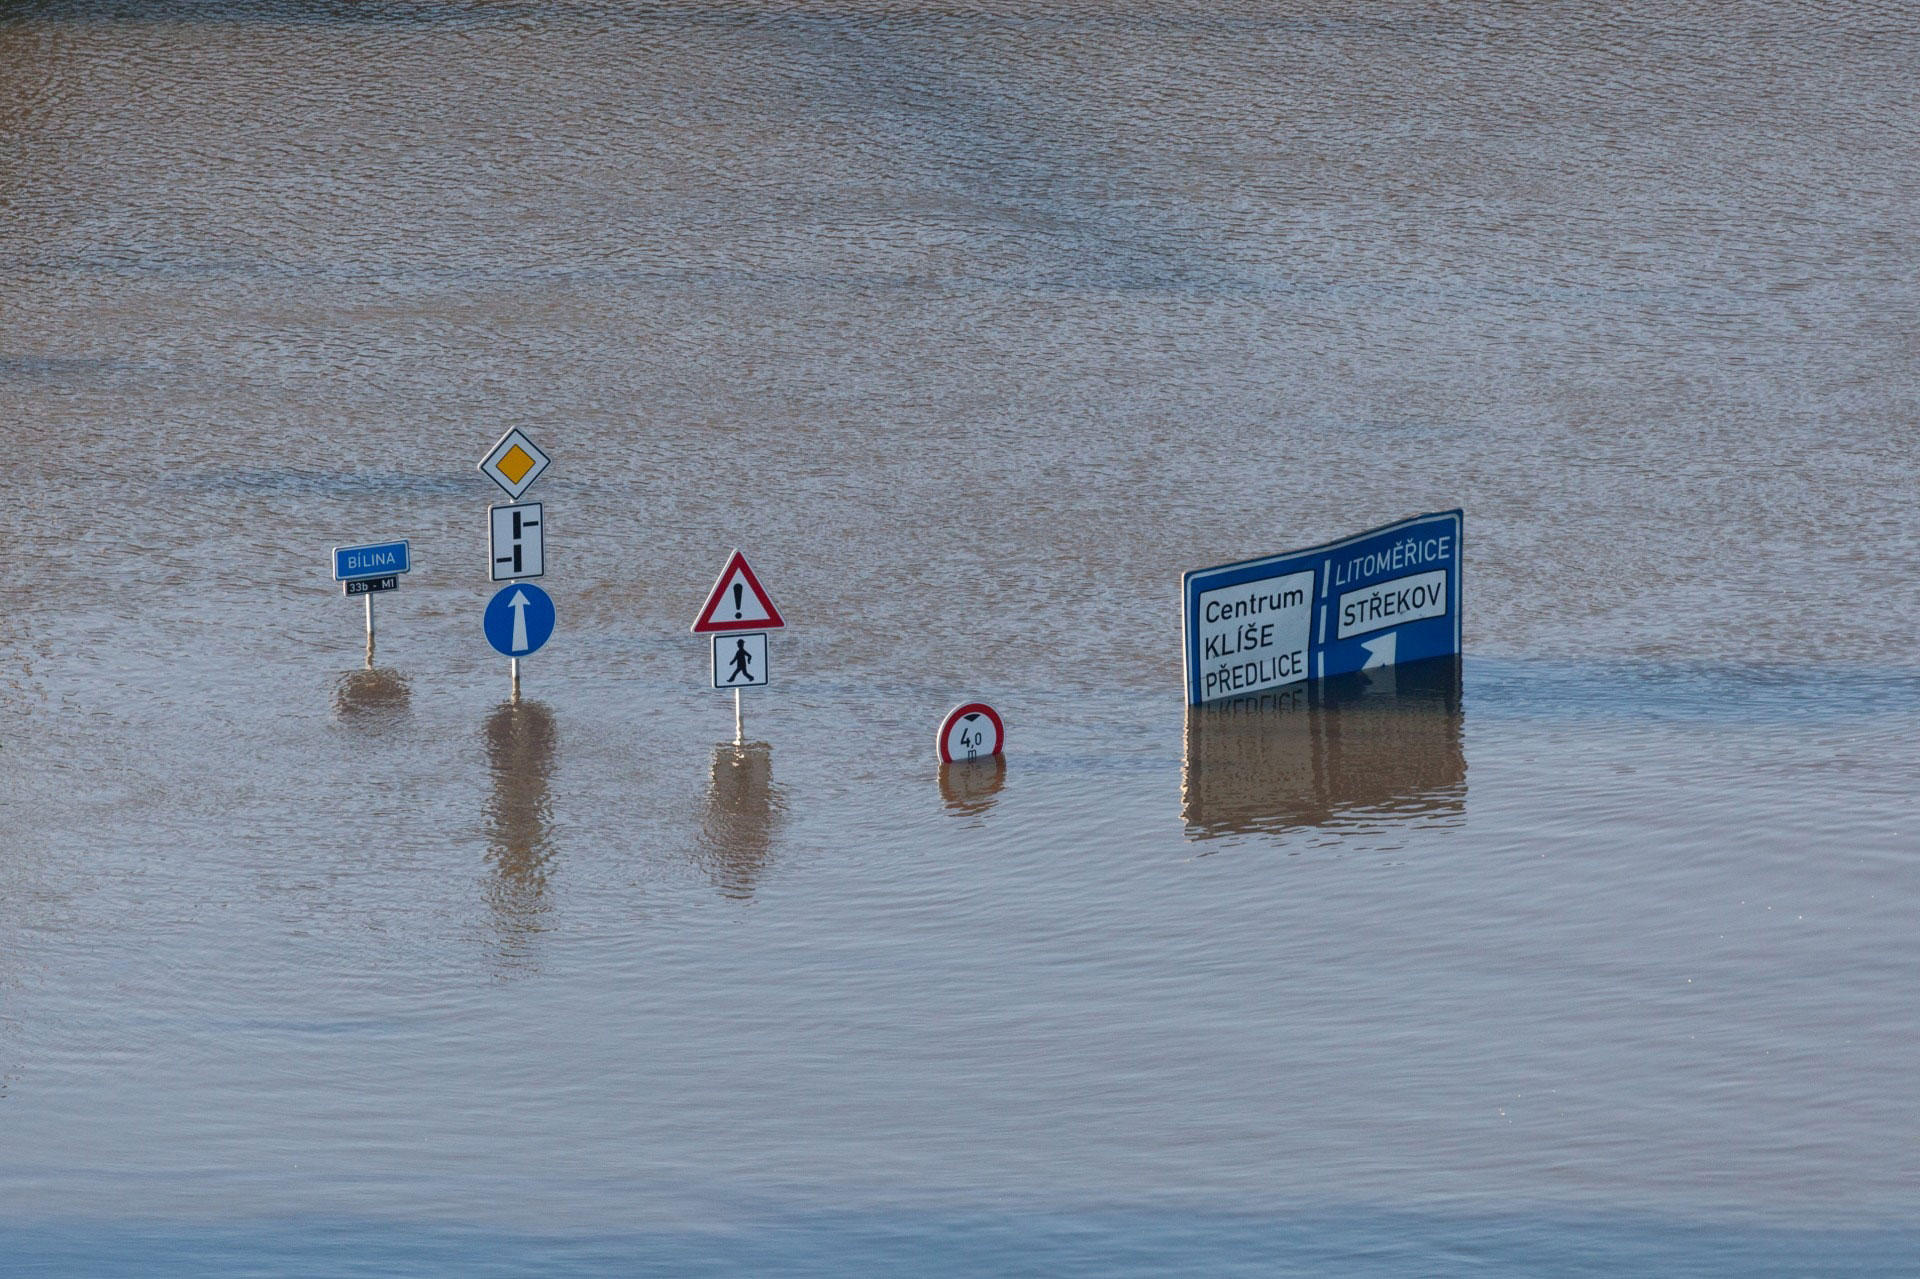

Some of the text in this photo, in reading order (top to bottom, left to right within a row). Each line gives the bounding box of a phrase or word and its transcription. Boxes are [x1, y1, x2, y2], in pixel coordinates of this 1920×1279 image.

[347, 552, 396, 569] BÍLINA
[1335, 536, 1451, 587] LITOMĚŘICE
[349, 582, 369, 593] 33b
[381, 578, 395, 589] M1
[1205, 589, 1304, 624] Centrum
[1343, 582, 1442, 627] STŘEKOV
[1205, 622, 1275, 661] KLÍŠE
[1205, 650, 1303, 697] PŘEDLICE
[960, 727, 982, 749] 4,0
